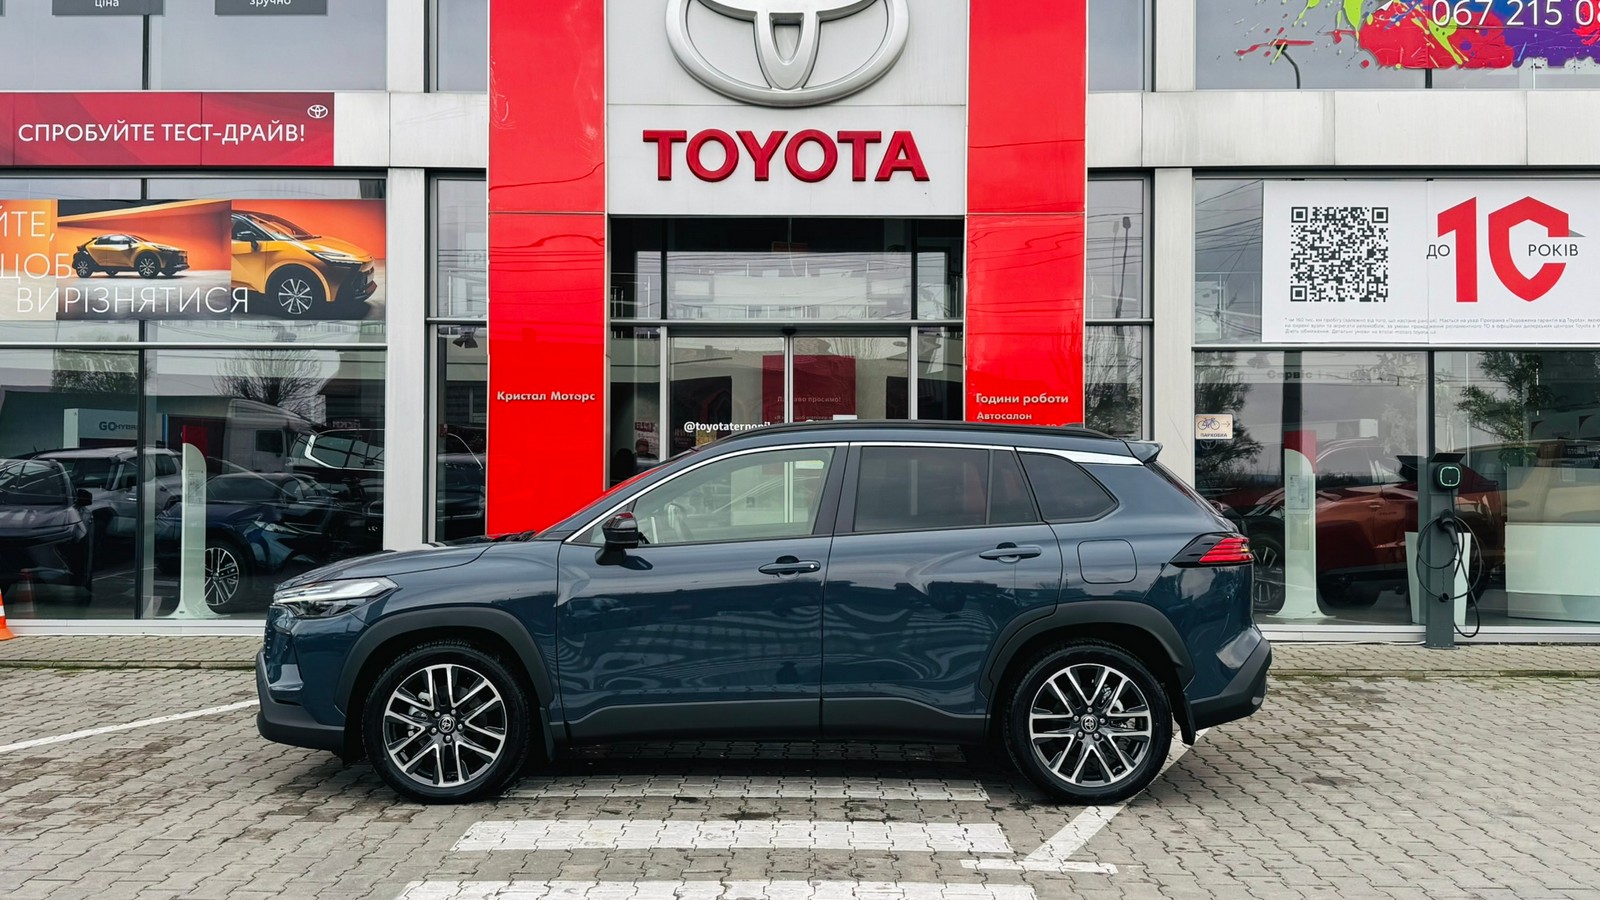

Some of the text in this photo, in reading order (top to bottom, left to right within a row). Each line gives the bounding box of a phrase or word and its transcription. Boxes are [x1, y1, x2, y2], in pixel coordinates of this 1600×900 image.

[1432, 0, 1600, 26] 067 215 0
[18, 120, 305, 145] СПРОБУЙТЕ ТЕСТ-ДРАЙВ!
[642, 129, 930, 183] TOYOTA
[1426, 244, 1451, 260] ДО
[1528, 244, 1579, 257] РОКІВ
[17, 287, 248, 313] ВИРІЗНЯТИСЯ
[497, 391, 596, 403] Кристал Моторс
[976, 392, 1069, 406] Години роботи
[976, 411, 1032, 420] Автосалон
